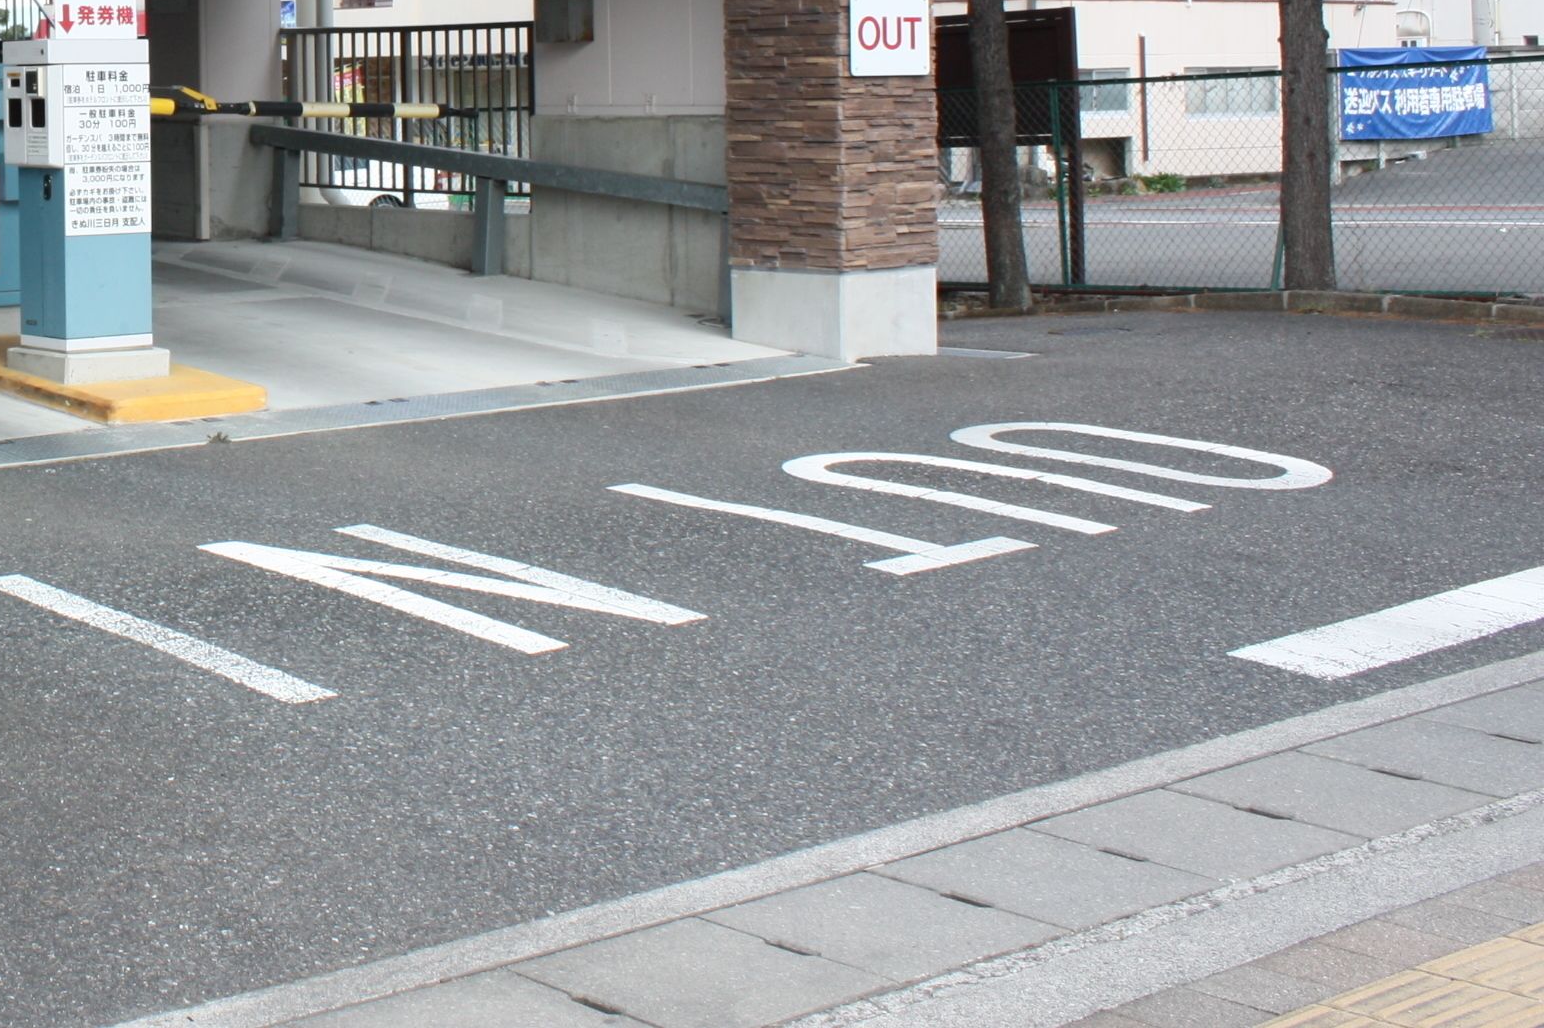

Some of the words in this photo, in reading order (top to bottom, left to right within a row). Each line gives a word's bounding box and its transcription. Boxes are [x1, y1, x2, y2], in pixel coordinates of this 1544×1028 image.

[77, 5, 135, 26] 発券機
[857, 15, 923, 51] OUT
[85, 70, 129, 83] 駐車料金
[114, 83, 150, 94] 1,000円
[79, 108, 136, 119] 一般駐車料金
[79, 119, 100, 130] 30分
[110, 118, 137, 129] 100円
[606, 421, 1334, 575] OUT
